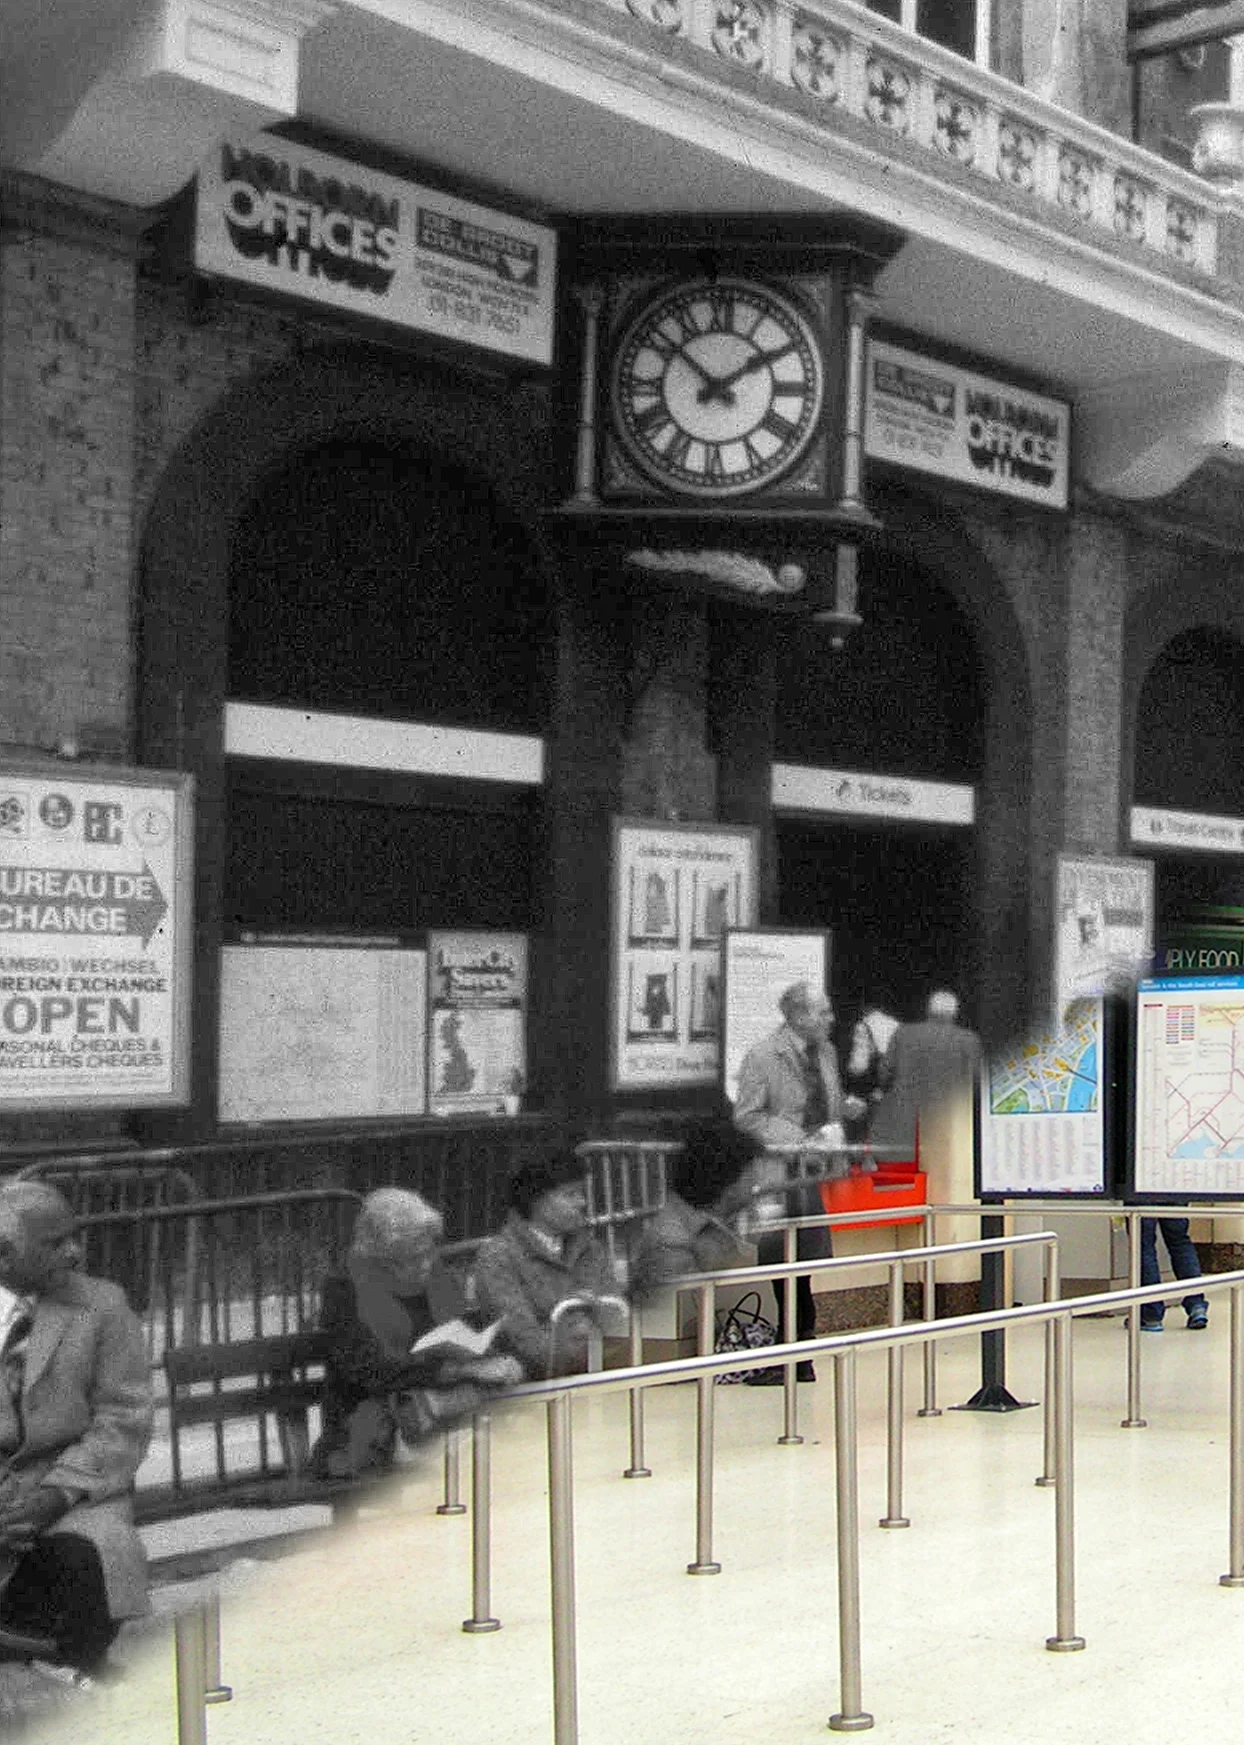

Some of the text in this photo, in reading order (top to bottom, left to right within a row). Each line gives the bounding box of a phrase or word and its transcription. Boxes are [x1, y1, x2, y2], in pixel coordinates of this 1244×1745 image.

[223, 179, 400, 270] OFFICES
[968, 414, 1058, 469] OFFICES
[0, 869, 153, 900] UREAU DE
[0, 903, 128, 932] CHANGE
[0, 956, 160, 975] MBIO WECHSEL
[1199, 948, 1239, 969] FOOD
[0, 975, 169, 993] REIGN EXCHANGE
[2, 996, 140, 1035] OPEN
[0, 1039, 67, 1054] RSONAL
[71, 1038, 146, 1053] CHEQUES
[86, 1053, 163, 1068] CHEQUES
